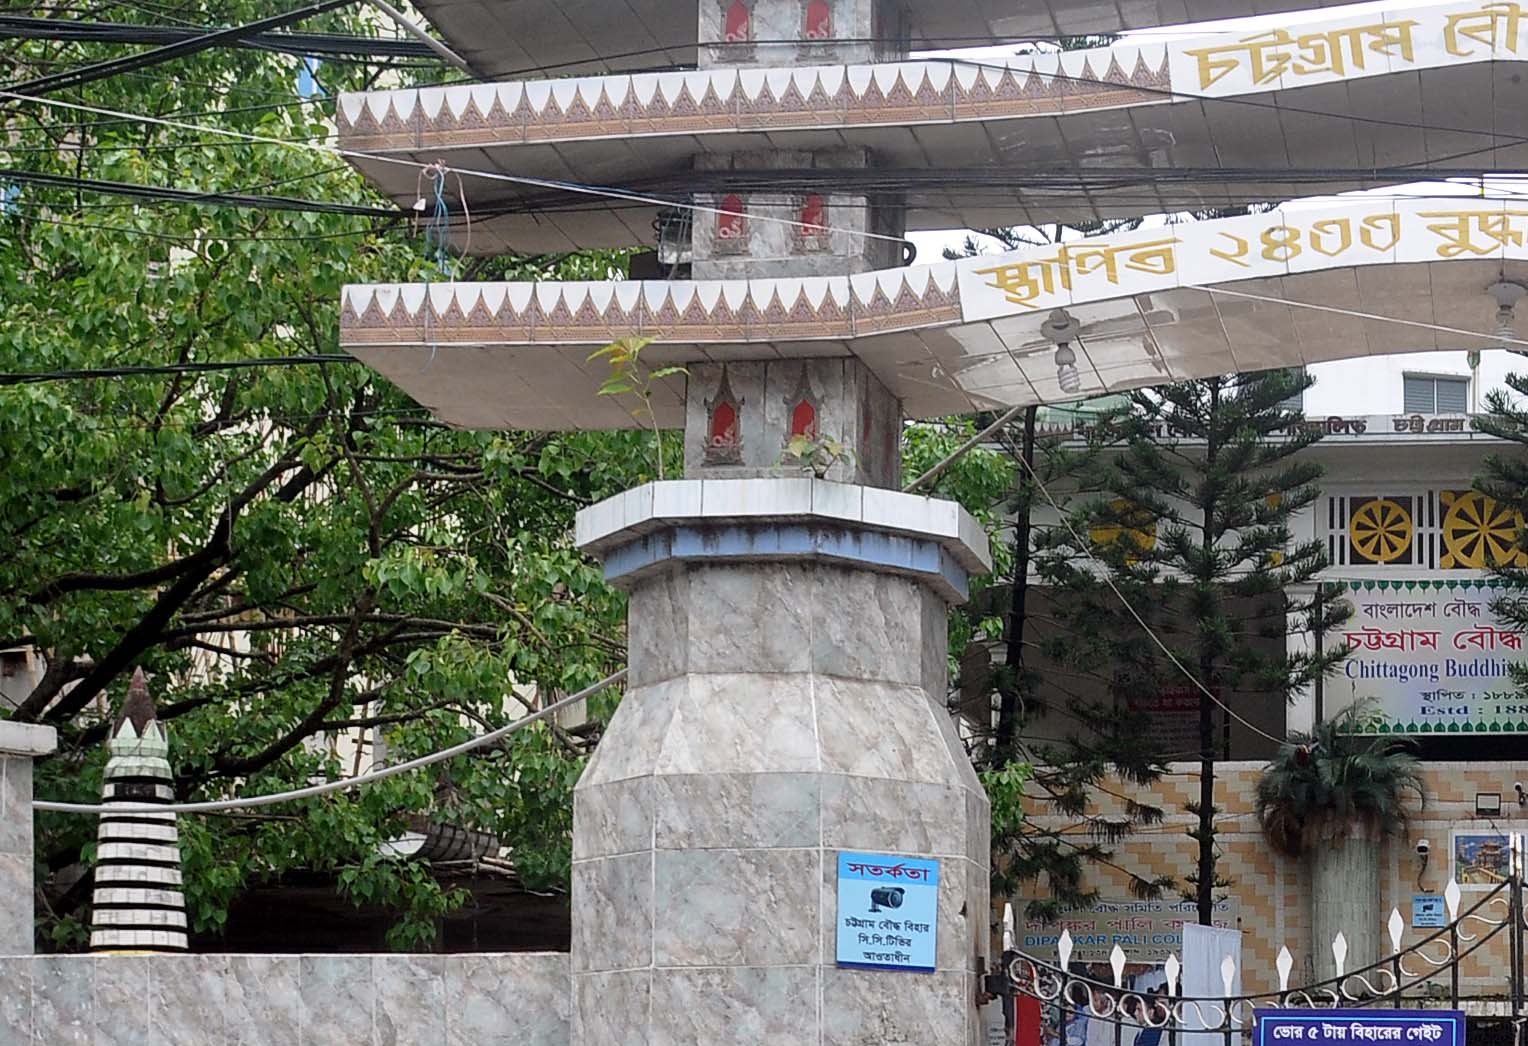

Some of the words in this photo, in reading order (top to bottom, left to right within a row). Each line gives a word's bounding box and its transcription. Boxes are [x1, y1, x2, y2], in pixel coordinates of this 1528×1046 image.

[1182, 18, 1423, 91] চট্টগ্রাম
[972, 237, 1184, 308] স্থাপিত
[1362, 602, 1437, 620] বাংলাদেশ
[1443, 598, 1482, 619] বৌদ্ধ
[1343, 625, 1442, 651] চট্টগ্রাম
[1454, 624, 1525, 650] বৌদ্ধ
[1345, 658, 1440, 682] Chittagong
[1446, 658, 1520, 679] Buddhis
[1419, 690, 1466, 702] স্থাপিত
[1420, 705, 1469, 717] Estd
[846, 862, 932, 881] সতর্কতা
[904, 920, 930, 934] বিহার
[1024, 934, 1107, 947] DIPAKAR
[1112, 934, 1149, 946] PALI
[1273, 1025, 1303, 1040] ভোর
[1308, 1028, 1318, 1040] ৫
[1322, 1023, 1346, 1040] টায়
[1351, 1023, 1402, 1041] বিহারের
[1406, 1024, 1443, 1042] গেইট
